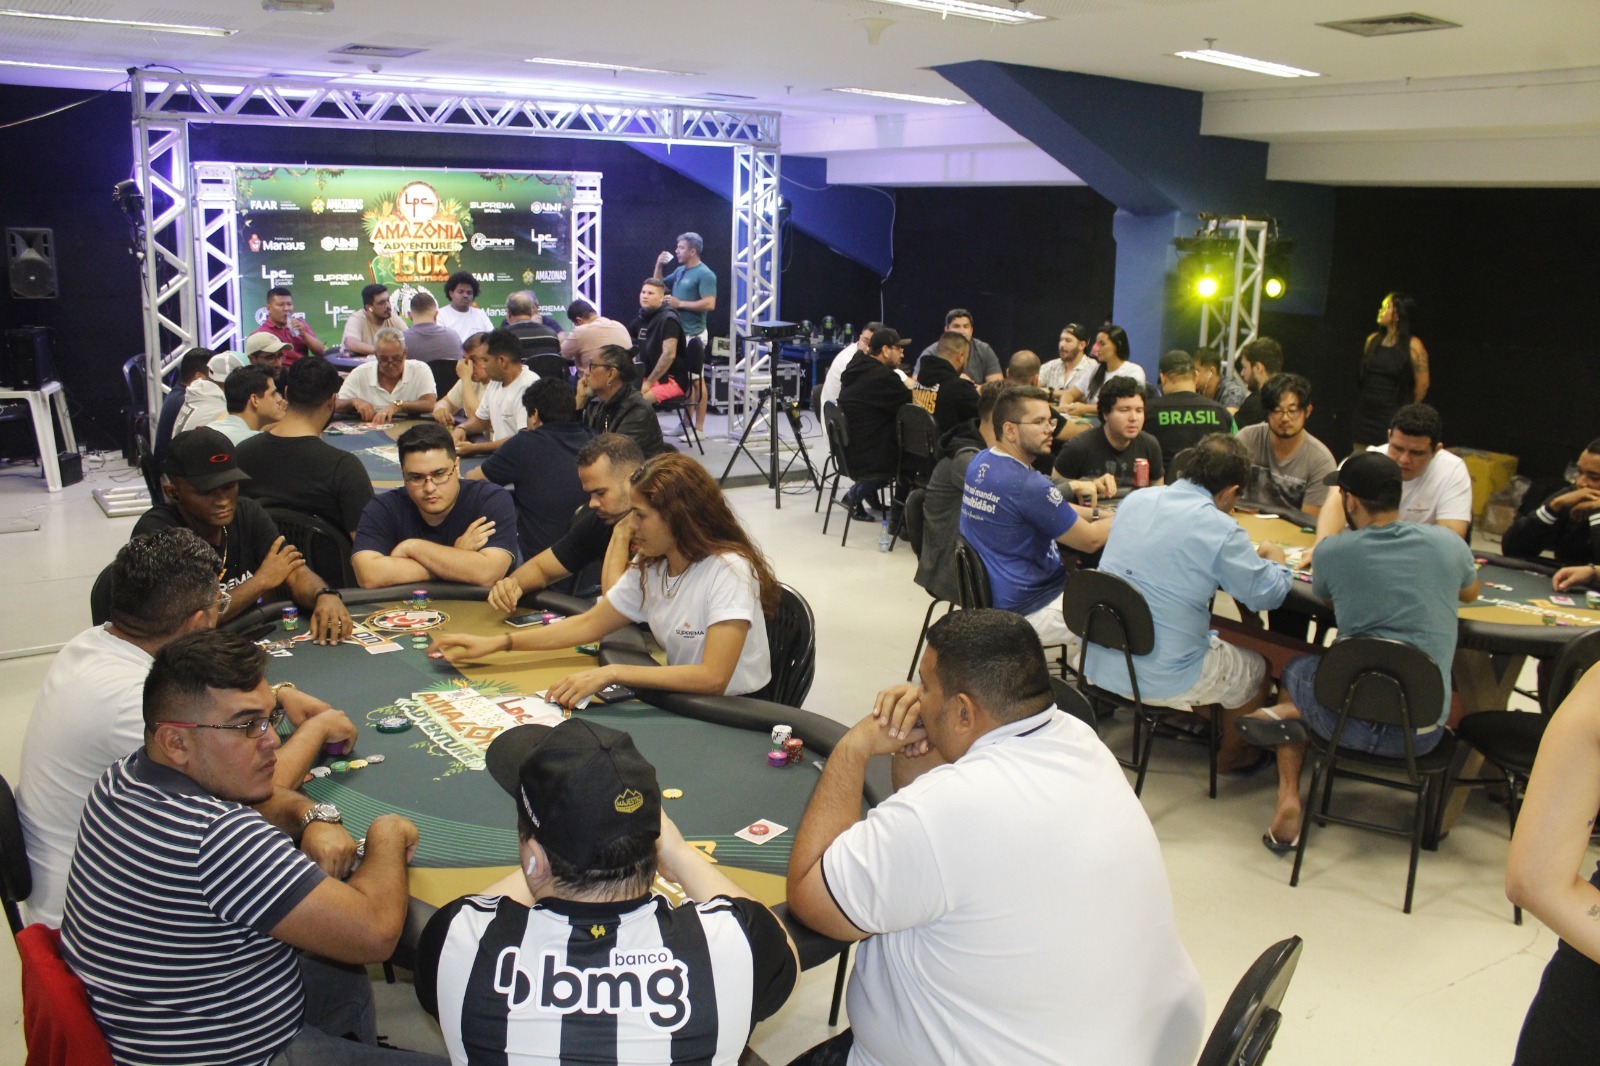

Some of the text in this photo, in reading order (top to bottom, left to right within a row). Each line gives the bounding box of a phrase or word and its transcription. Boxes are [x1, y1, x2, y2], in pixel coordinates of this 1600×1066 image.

[250, 200, 278, 210] FAAR
[469, 201, 516, 209] SUPREMA
[542, 202, 562, 212] UNI
[262, 240, 306, 251] Manaus
[383, 241, 453, 250] ADVENTURE
[392, 250, 449, 275] 150K
[313, 273, 365, 282] SUPREMA
[535, 270, 567, 281] AMAZONAS
[481, 307, 507, 317] Mana
[537, 304, 566, 312] PREMA
[1158, 410, 1220, 426] BRASIL
[219, 570, 254, 592] REMA
[614, 952, 668, 966] banco
[540, 954, 687, 1028] bmg
